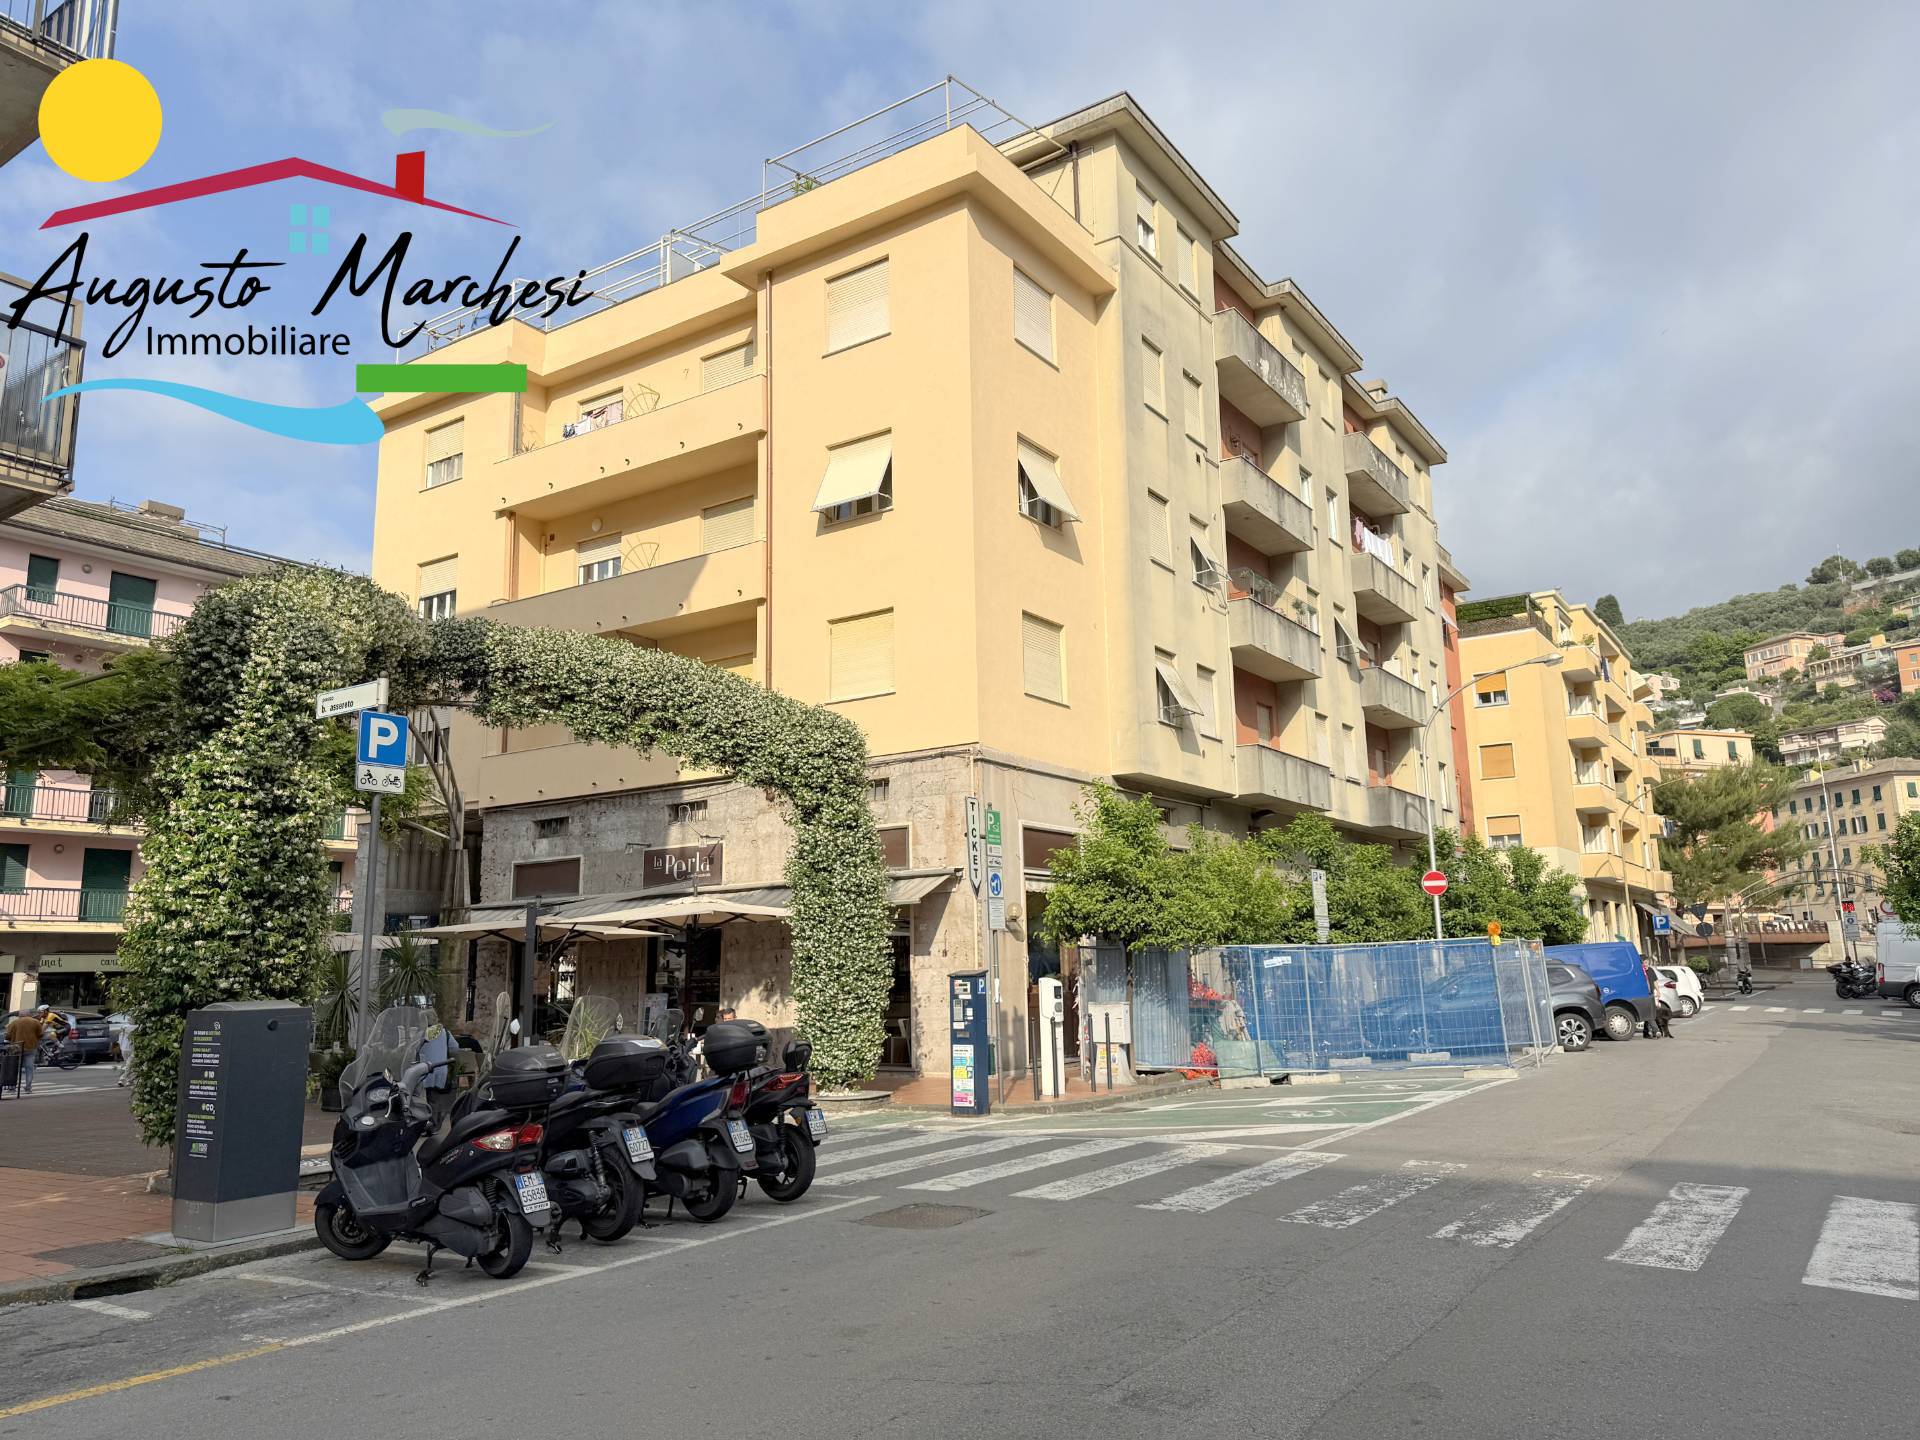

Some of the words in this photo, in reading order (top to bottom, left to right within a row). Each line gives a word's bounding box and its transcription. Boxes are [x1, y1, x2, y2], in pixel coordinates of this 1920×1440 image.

[329, 700, 353, 711] assereto
[368, 717, 399, 759] P
[969, 801, 979, 880] TICKET
[653, 855, 663, 868] la
[665, 850, 711, 881] Perla
[521, 1187, 546, 1203] 55838
